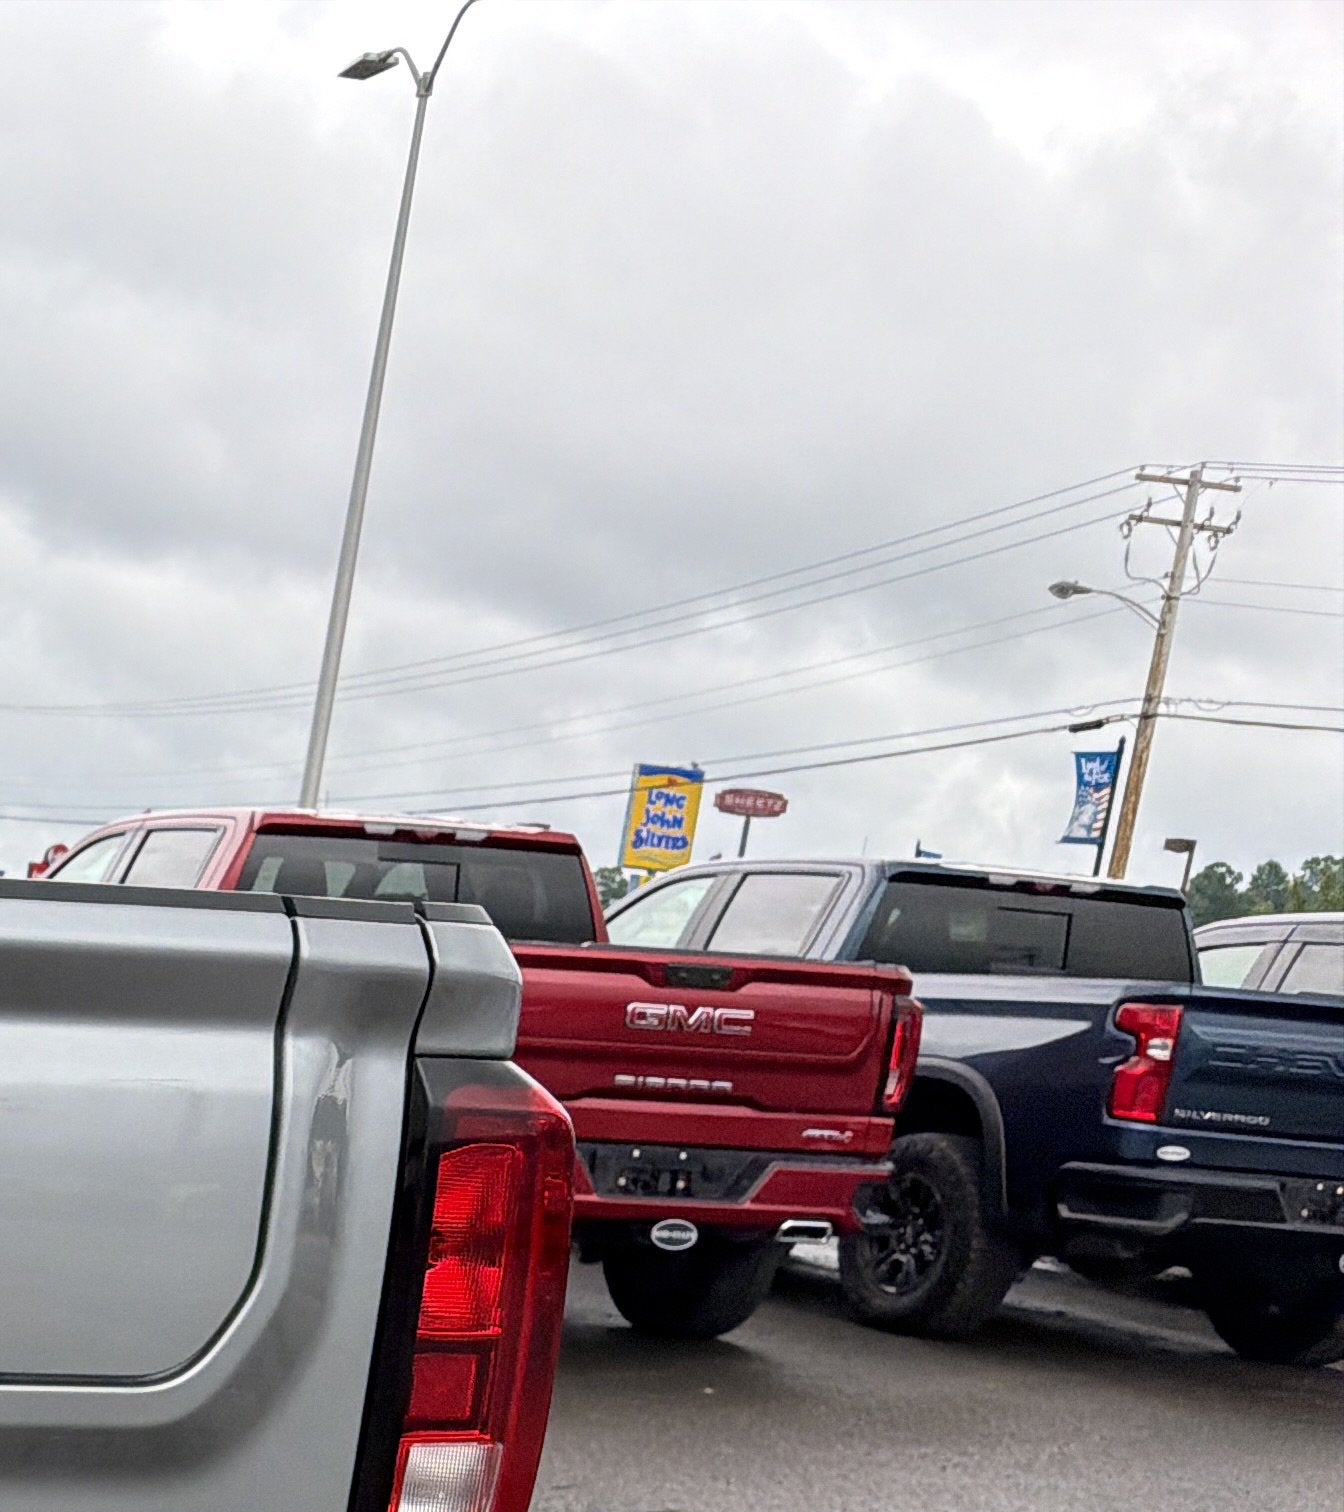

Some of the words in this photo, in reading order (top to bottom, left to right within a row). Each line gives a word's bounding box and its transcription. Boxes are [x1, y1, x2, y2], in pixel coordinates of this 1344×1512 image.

[724, 793, 785, 812] SHEETZ
[626, 1001, 755, 1036] GMC
[1173, 1108, 1271, 1127] SILVERADO
